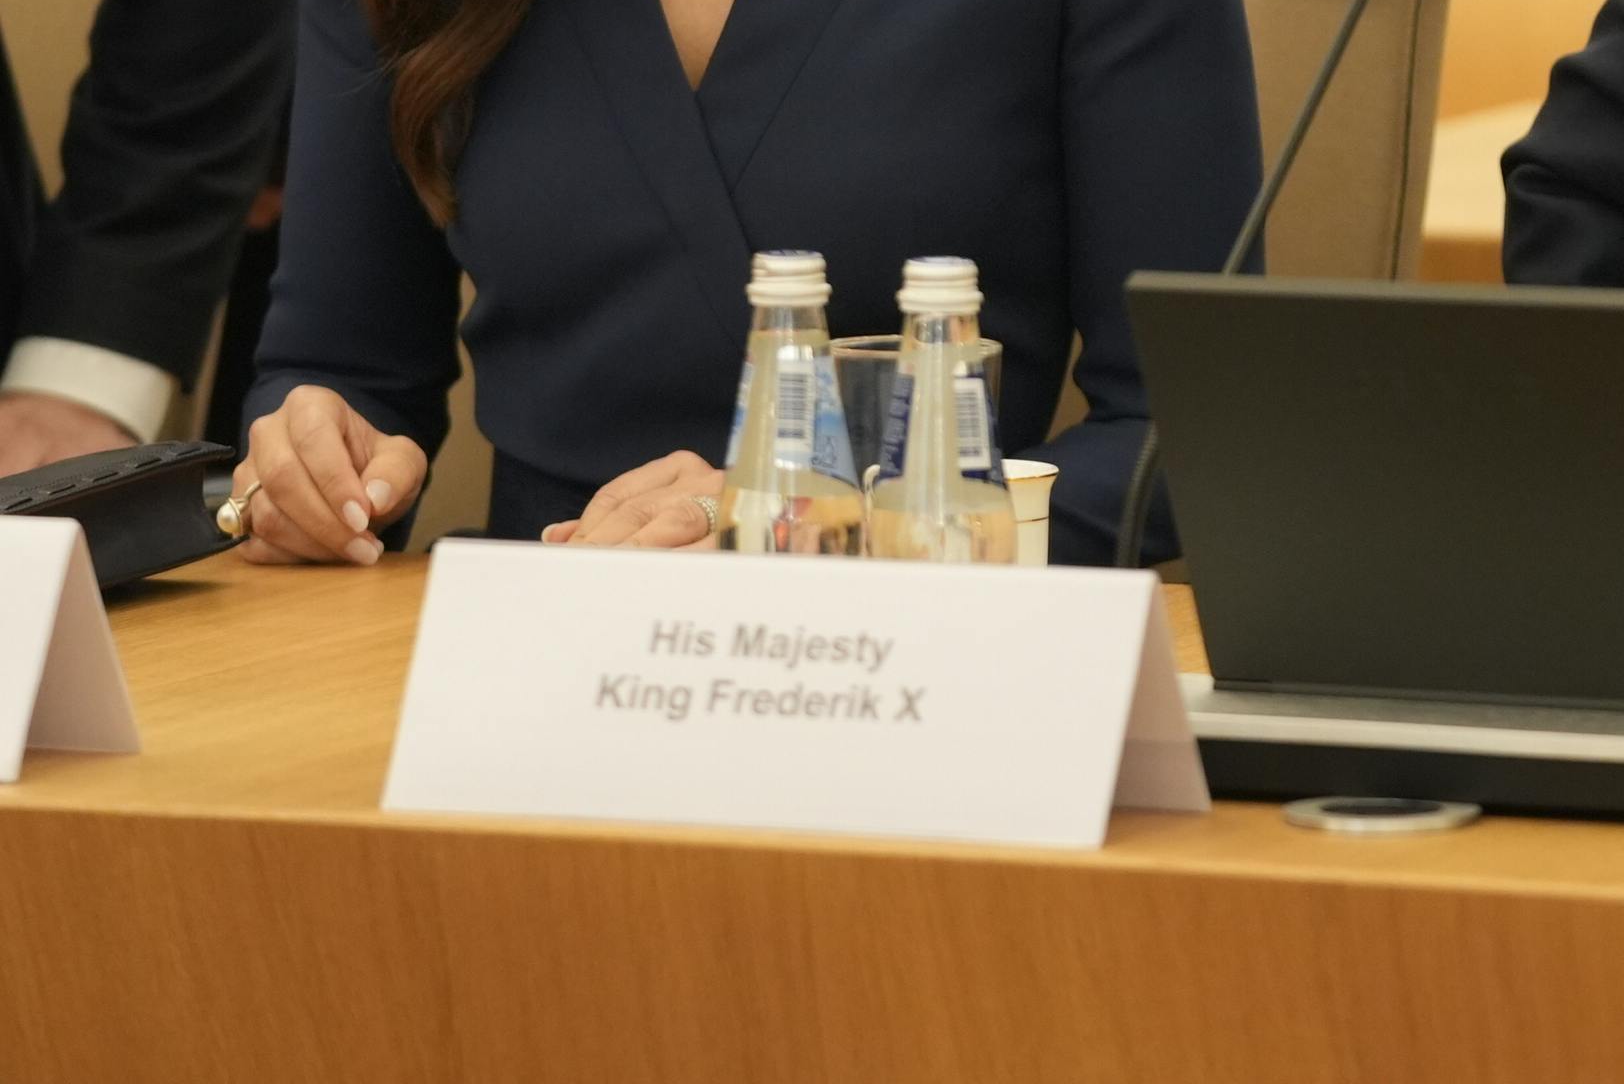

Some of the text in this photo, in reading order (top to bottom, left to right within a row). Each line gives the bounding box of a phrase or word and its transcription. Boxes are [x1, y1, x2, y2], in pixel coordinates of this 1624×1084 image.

[650, 620, 894, 673] His Majesty
[596, 672, 925, 722] King Frederik X
